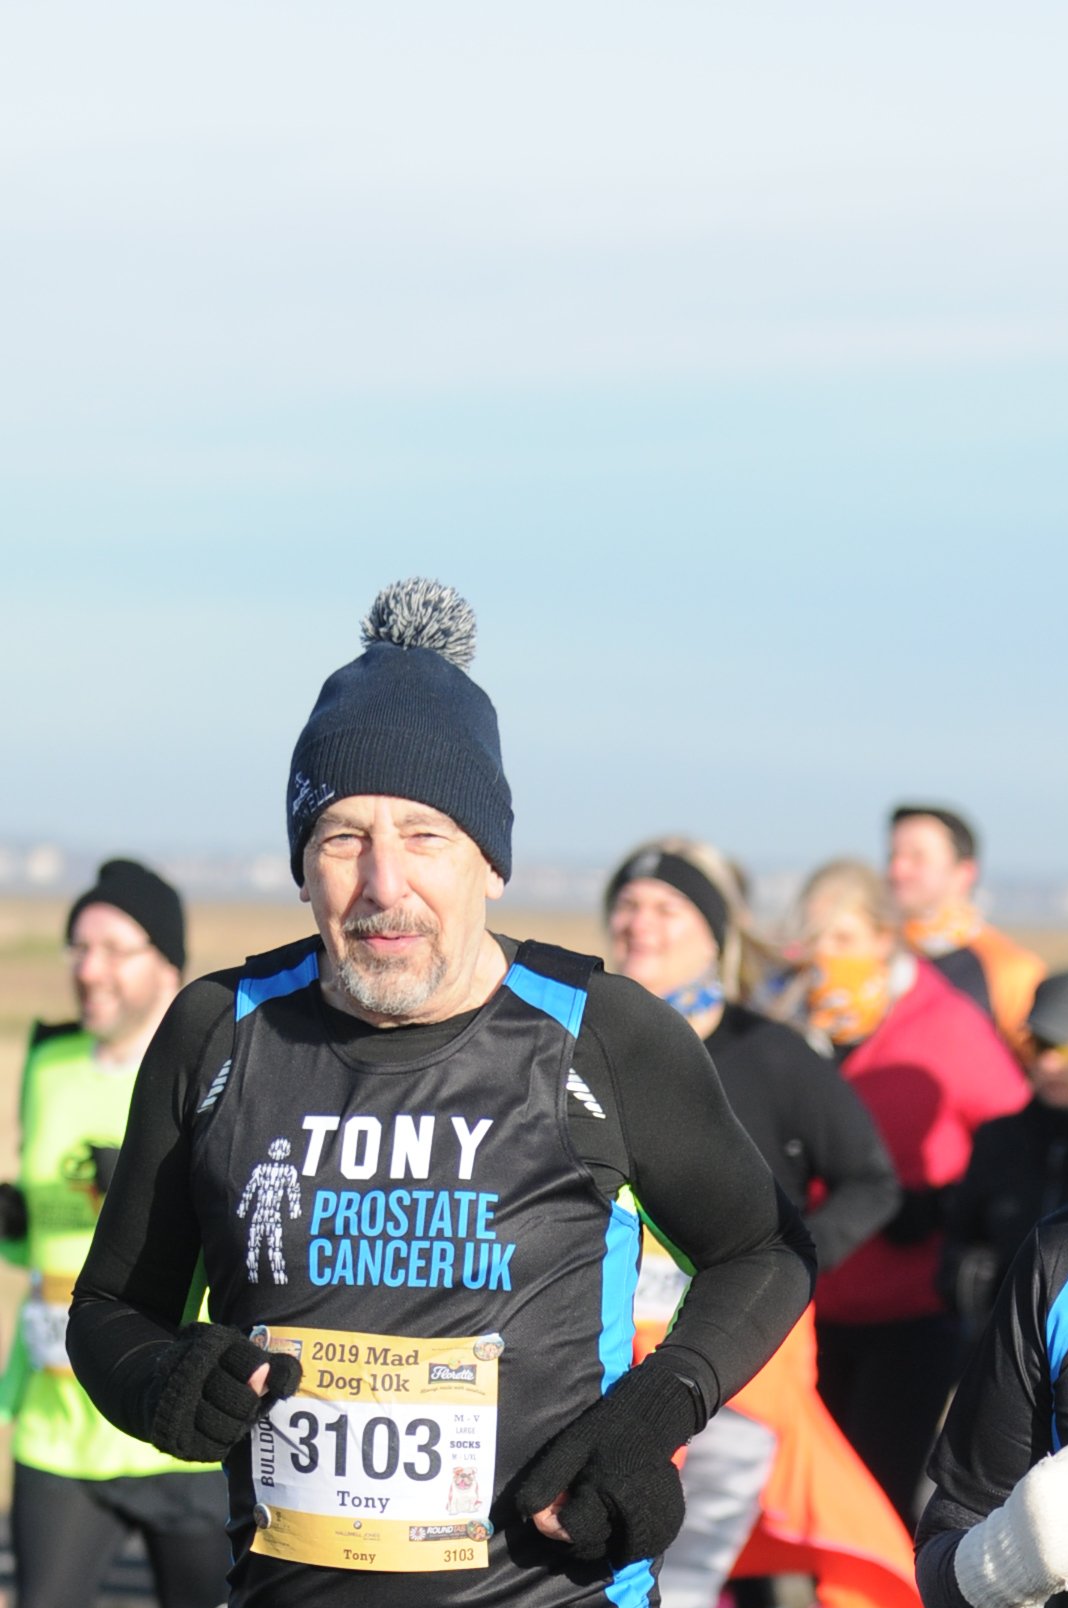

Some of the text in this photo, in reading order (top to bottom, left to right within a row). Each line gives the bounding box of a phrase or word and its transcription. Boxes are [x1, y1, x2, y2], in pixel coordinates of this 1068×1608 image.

[301, 1115, 494, 1180] TONY
[310, 1189, 498, 1240] PROSTATE
[309, 1239, 516, 1291] CANCER UK
[312, 1341, 359, 1364] 2019
[364, 1346, 420, 1367] Mad
[316, 1369, 362, 1396] Dog
[370, 1373, 410, 1392] 10k
[258, 1416, 275, 1488] BULLDO
[289, 1411, 442, 1482] 3103
[449, 1440, 481, 1449] SOCKS
[337, 1490, 391, 1513] Tony
[427, 1526, 453, 1535] ROUND
[343, 1549, 376, 1564] Tony
[443, 1548, 474, 1562] 3103
